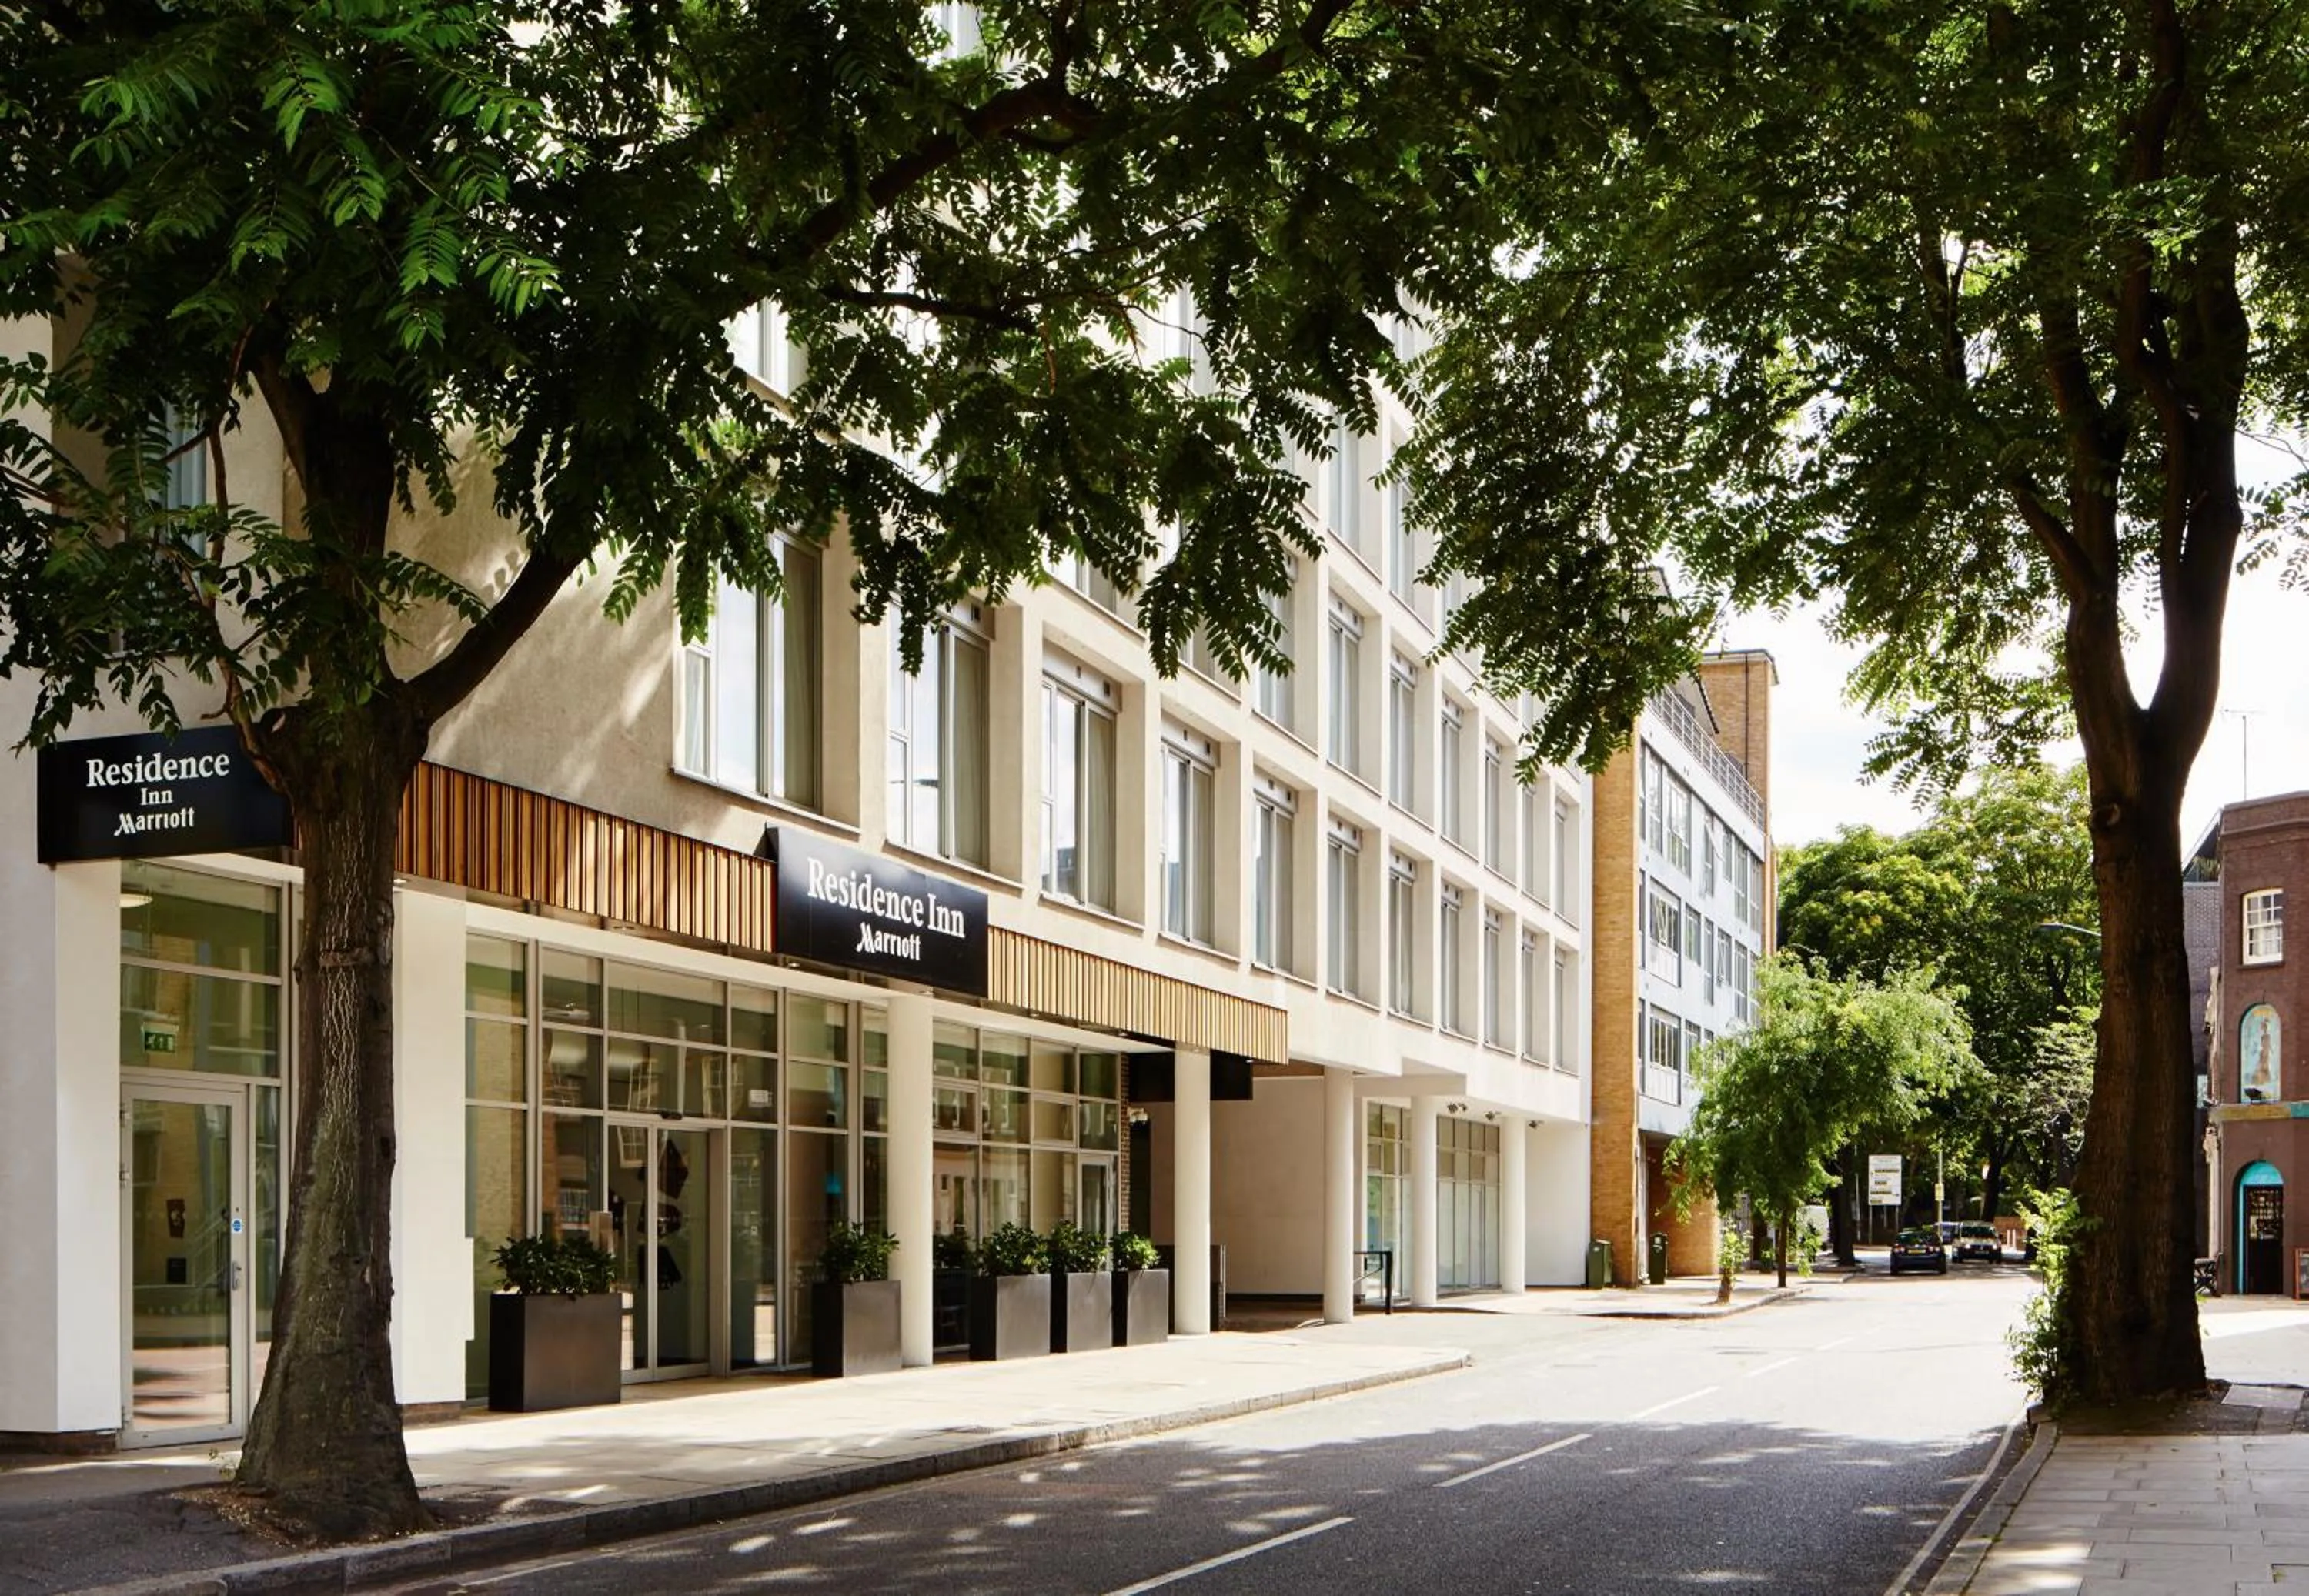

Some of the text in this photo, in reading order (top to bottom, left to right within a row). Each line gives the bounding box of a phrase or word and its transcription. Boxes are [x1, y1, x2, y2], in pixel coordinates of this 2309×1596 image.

[86, 752, 230, 787] Residence
[140, 787, 172, 805] Inn
[114, 807, 195, 836] Marriott
[807, 856, 965, 938] Residence Inn
[856, 921, 921, 960] Marriott
